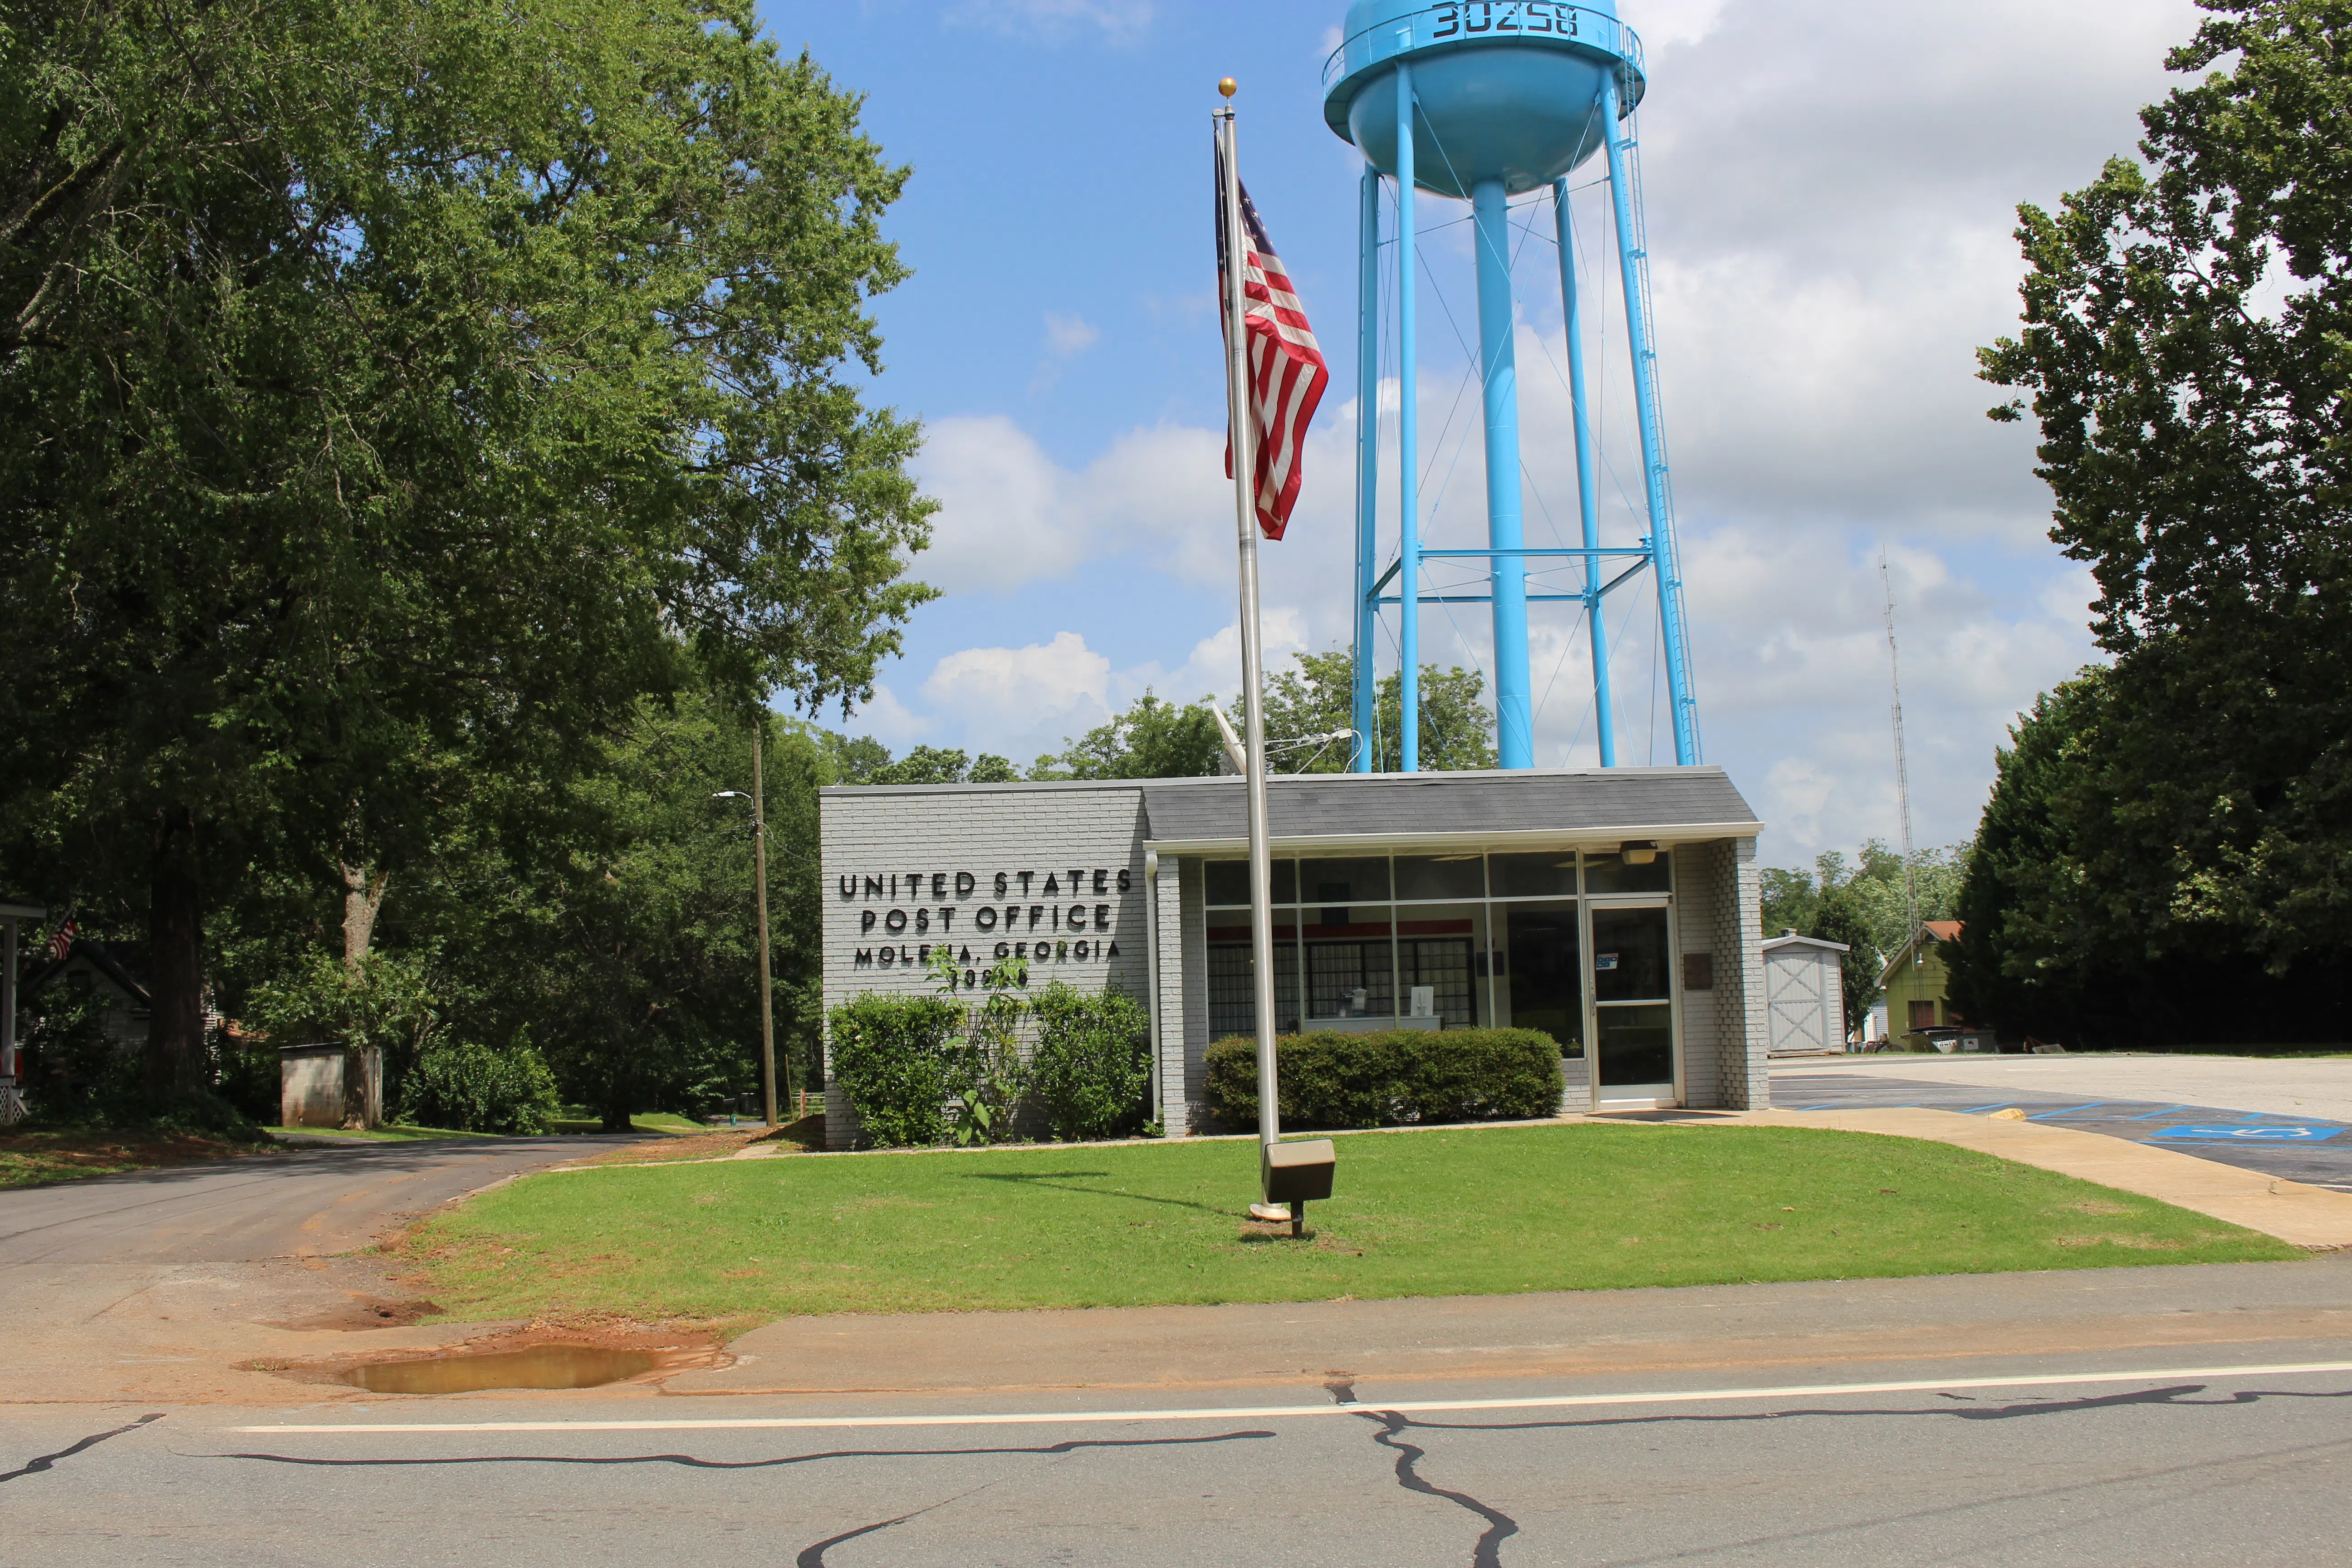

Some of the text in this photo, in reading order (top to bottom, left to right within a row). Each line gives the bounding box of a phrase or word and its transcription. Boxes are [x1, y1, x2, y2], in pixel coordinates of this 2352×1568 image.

[1432, 0, 1577, 38] 30258
[841, 869, 1131, 896] UNITED STATES
[862, 905, 1110, 932] POST OFFICE
[855, 940, 1120, 963] MOLEA, GEORGIA
